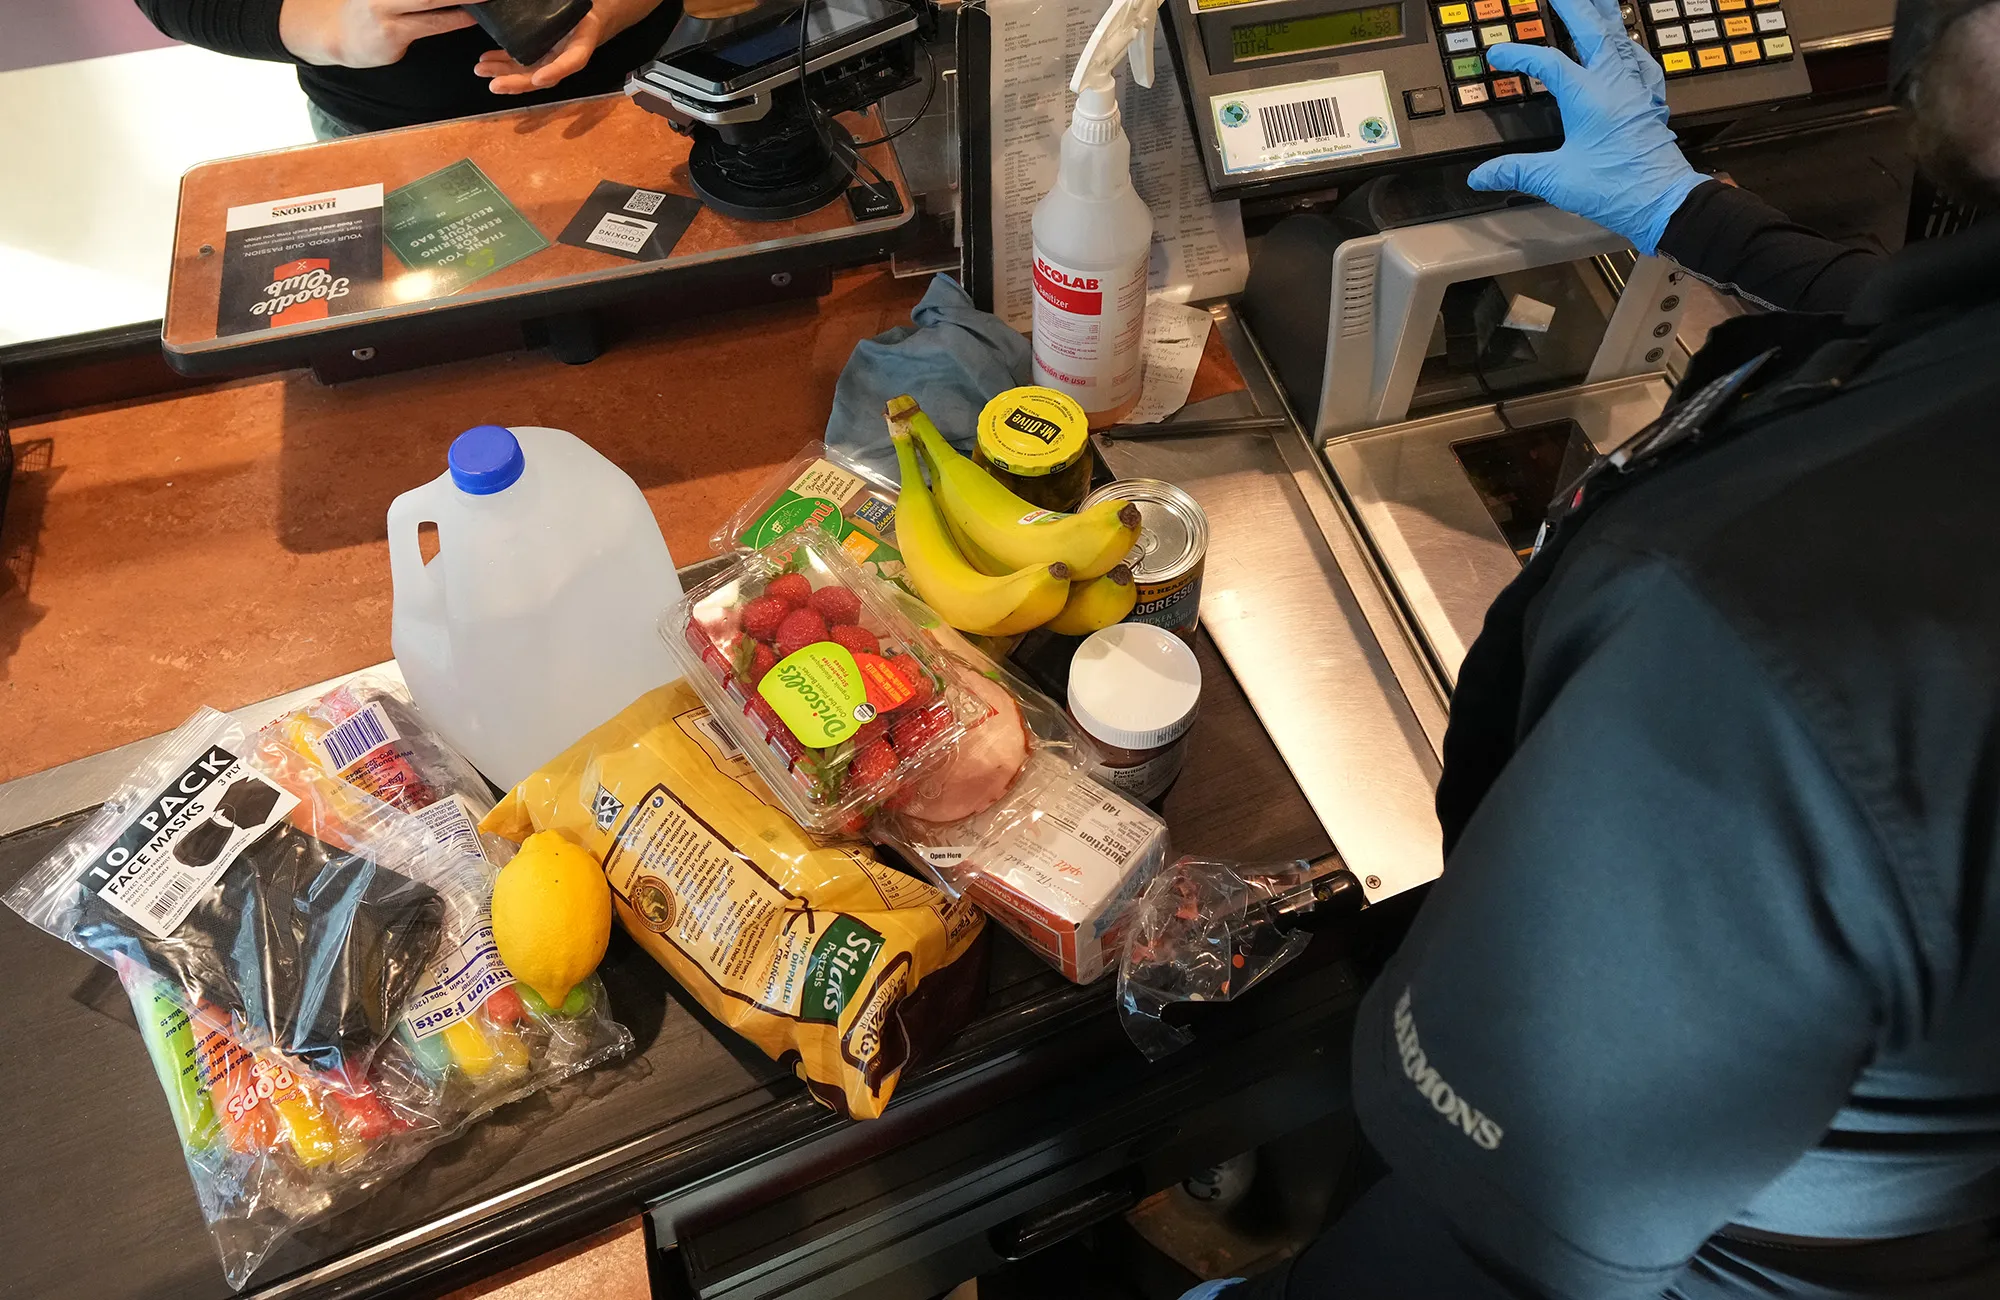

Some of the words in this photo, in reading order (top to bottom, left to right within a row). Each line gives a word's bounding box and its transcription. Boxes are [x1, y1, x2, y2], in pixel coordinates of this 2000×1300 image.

[1655, 6, 1673, 14] Grocery
[1523, 25, 1537, 33] Check
[1692, 26, 1715, 35] Hardware
[1731, 25, 1747, 33] Beauty
[1765, 17, 1777, 25] Dept
[1231, 27, 1255, 41] TAX
[1263, 22, 1290, 36] DUE
[1453, 36, 1468, 44] Credit
[1233, 37, 1274, 55] TOTAL
[1704, 53, 1720, 61] Bakery
[1297, 147, 1321, 156] Reusable
[1322, 145, 1333, 153] Bag
[1333, 142, 1352, 150] Points
[271, 201, 336, 217] HARMONS
[436, 204, 493, 236] REUSABLE
[604, 222, 646, 237] SCHOOL
[337, 232, 361, 241] YOUR
[409, 231, 435, 249] BAG
[420, 215, 501, 259] REMEMBERING
[440, 221, 473, 242] YOUR
[593, 234, 637, 248] HARMONS
[597, 228, 641, 242] COOKING
[241, 245, 283, 257] PASSION.
[285, 242, 305, 250] OUR
[307, 237, 335, 246] FOOD.
[454, 234, 478, 250] FOR
[465, 230, 505, 253] THANK
[437, 249, 463, 267] YOU
[263, 268, 331, 296] Club
[1038, 257, 1099, 291] ECOLAB
[248, 277, 350, 315] Foodie
[1039, 284, 1069, 309] Sanitizer
[1059, 373, 1069, 382] de
[1070, 377, 1086, 386] uso
[793, 478, 806, 491] GREAT
[805, 469, 816, 480] WITH
[860, 500, 873, 512] NEW
[869, 504, 888, 522] MORE
[875, 505, 896, 530] cheese!
[1136, 582, 1193, 615] OGRESSO
[801, 666, 817, 684] Berries
[808, 652, 832, 680] Biologiques
[820, 656, 848, 687] Strawberries
[832, 658, 849, 678] Fraises
[776, 663, 846, 736] Driscoll's
[814, 682, 830, 699] Finest
[832, 680, 850, 701] Organic
[827, 696, 836, 707] the
[833, 704, 846, 718] Only
[329, 749, 413, 796] www.budgetsaver.com
[344, 748, 393, 781] 800-322-3642
[1113, 765, 1146, 775] Nutrition
[216, 777, 227, 787] 3
[225, 763, 242, 778] PLY
[88, 844, 130, 879] 10
[138, 749, 231, 831] PACK
[666, 809, 674, 818] at
[1101, 801, 1122, 817] 140
[666, 817, 687, 843] question
[668, 813, 681, 828] your
[1128, 820, 1149, 836] Calories
[107, 852, 151, 895] FACE
[150, 801, 205, 851] MASKS
[651, 825, 673, 853] favorite?
[679, 830, 698, 852] flavors
[1078, 830, 1125, 865] Nutrition
[1101, 833, 1131, 858] Facts
[620, 815, 670, 890] www.snydersofhanover.com
[646, 851, 656, 862] Tell
[653, 846, 669, 865] which
[680, 841, 700, 867] varieties
[692, 838, 713, 864] Snyder's
[660, 853, 673, 869] only
[664, 856, 680, 877] choose
[696, 857, 710, 873] With
[704, 861, 717, 877] slow
[714, 857, 730, 876] finest
[1003, 851, 1034, 876] secret
[1052, 854, 1085, 882] split
[119, 879, 139, 900] PROTECT
[137, 867, 151, 880] YOUR
[149, 848, 169, 867] FRIENDS
[124, 883, 144, 903] PROTECT
[143, 870, 156, 884] YOUR
[154, 855, 171, 871] FAMILY
[711, 873, 729, 894] family
[1031, 868, 1055, 890] The
[129, 887, 150, 907] PROTECT
[148, 865, 170, 887] YOURSELF
[680, 878, 695, 897] many
[692, 875, 708, 895] baked
[715, 877, 737, 903] Starting
[701, 891, 716, 910] recipe
[707, 901, 720, 916] with
[724, 899, 739, 916] ways
[732, 902, 748, 920] tasty
[743, 903, 758, 919] with
[1018, 903, 1049, 924] NOOKS
[687, 920, 700, 935] only
[692, 919, 709, 943] century
[722, 918, 737, 936] snack
[732, 917, 748, 936] cheese
[474, 939, 493, 952] serving
[746, 939, 761, 960] expect
[781, 928, 798, 960] They're
[796, 934, 813, 966] They're
[484, 951, 498, 960] size
[707, 945, 722, 963] many
[715, 942, 733, 967] hummus
[728, 946, 741, 963] their
[483, 959, 497, 970] per
[730, 958, 744, 977] Sticks
[740, 959, 752, 975] from
[762, 948, 783, 1000] CRUNCHY!
[813, 942, 837, 988] Pretzels
[823, 931, 872, 1013] Sticks
[447, 976, 465, 991] Twin
[459, 967, 486, 991] container
[463, 971, 470, 979] 2
[781, 952, 800, 1004] DIPPABLE!
[883, 977, 896, 990] OF
[466, 968, 512, 1002] trition
[414, 1000, 465, 1032] Facts
[858, 987, 889, 1030] HANOVER
[163, 1025, 178, 1039] our
[183, 1038, 205, 1058] comes
[207, 1036, 230, 1057] That's
[210, 1043, 238, 1069] reasons
[180, 1063, 195, 1077] our
[193, 1064, 213, 1083] these
[226, 1068, 295, 1123] POPS
